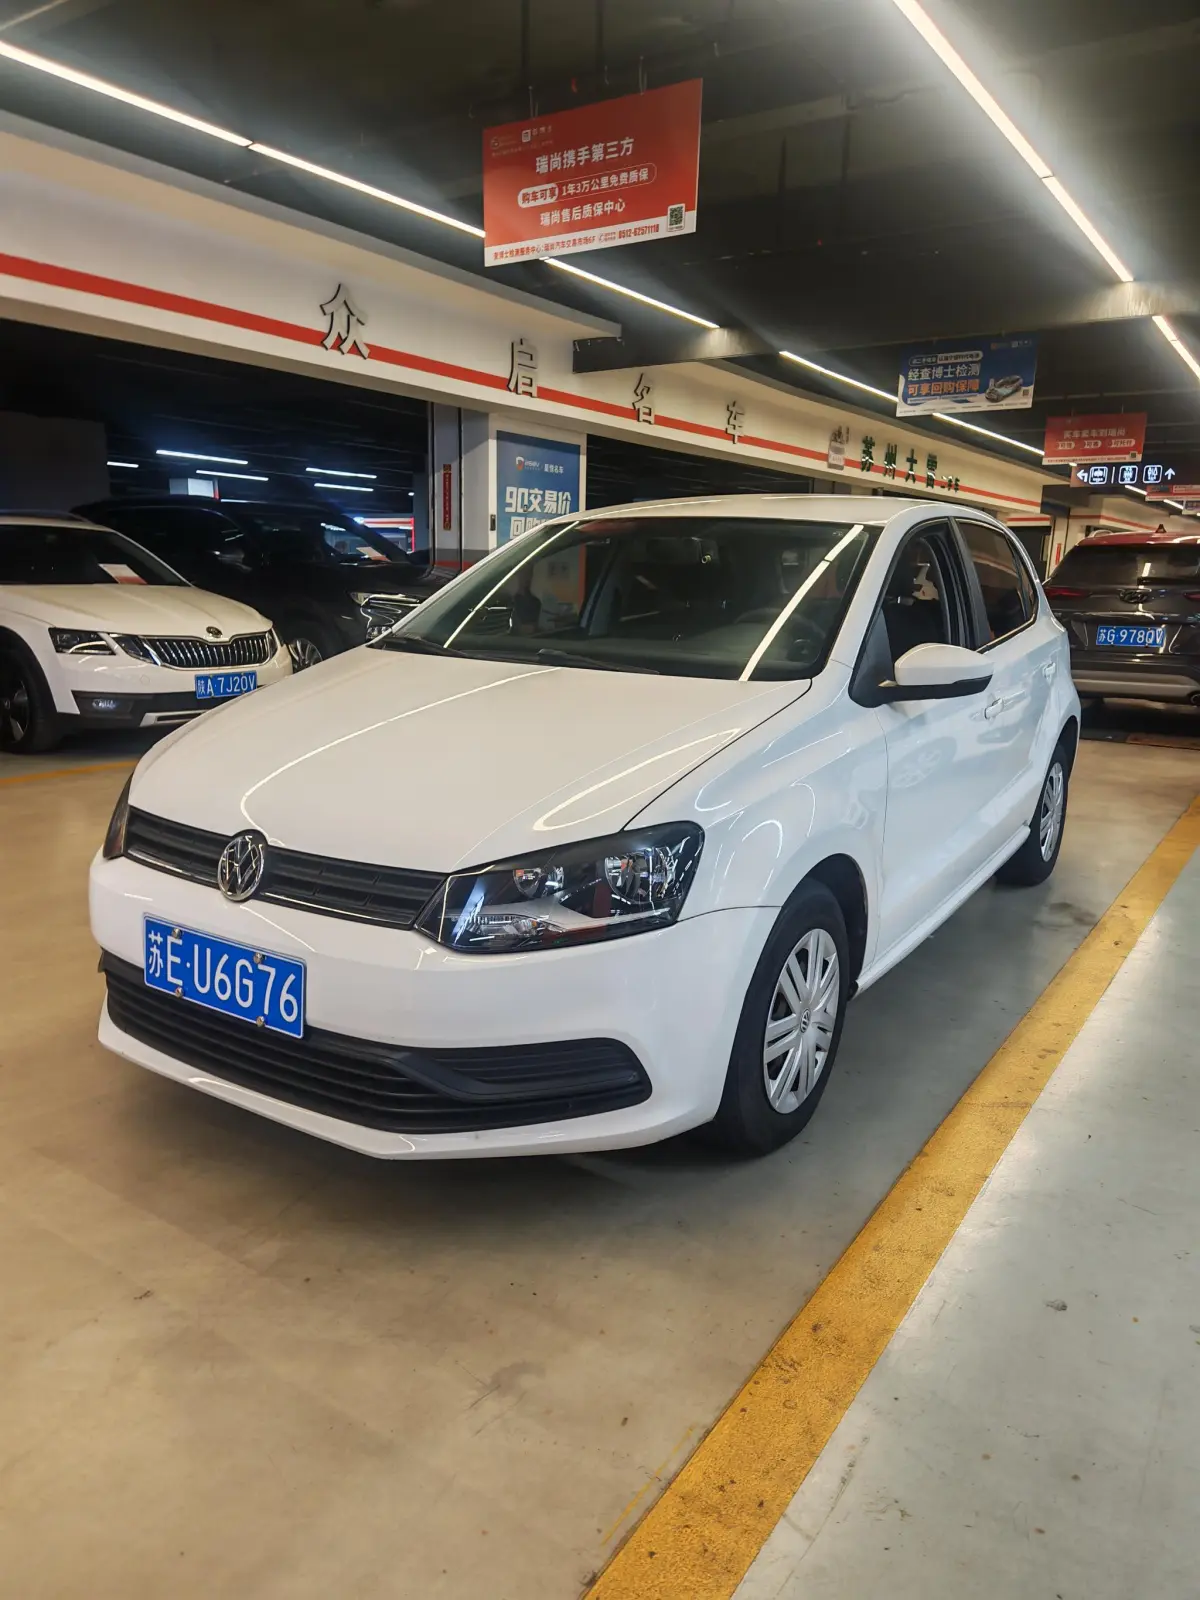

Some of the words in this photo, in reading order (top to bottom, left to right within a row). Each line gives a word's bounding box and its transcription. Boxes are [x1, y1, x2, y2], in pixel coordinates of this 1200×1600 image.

[535, 137, 634, 174] 瑞尚携手第三方
[562, 168, 649, 196] 1年3万公里免费质保
[539, 198, 626, 227] 瑞尚售后质保中心
[908, 363, 981, 381] 经查博士检测
[907, 379, 980, 397] 可享回购保障
[861, 435, 938, 489] 苏州大雷
[148, 930, 299, 1023] 苏E·U6G76
